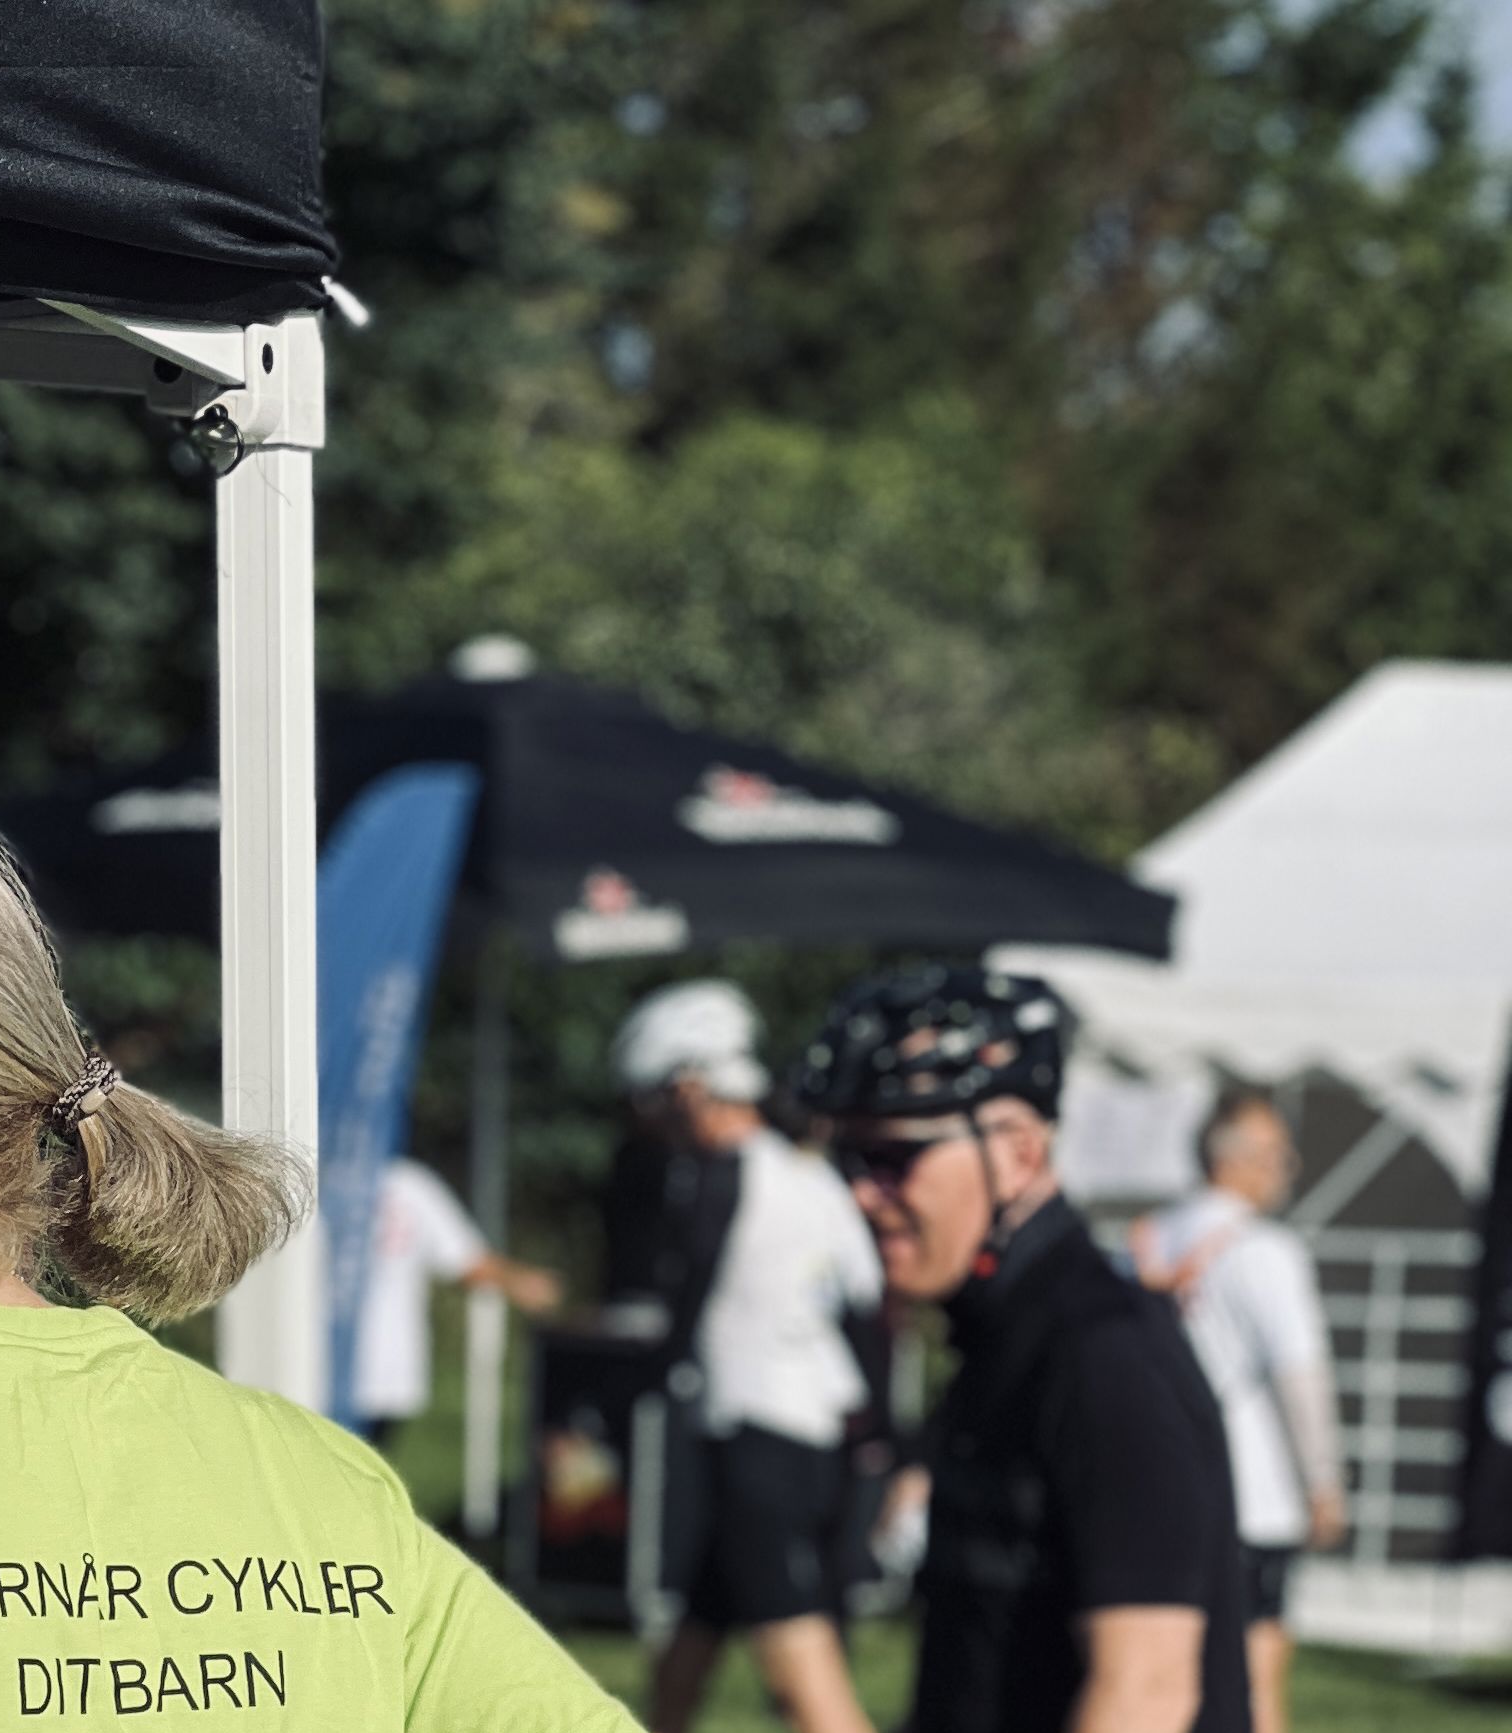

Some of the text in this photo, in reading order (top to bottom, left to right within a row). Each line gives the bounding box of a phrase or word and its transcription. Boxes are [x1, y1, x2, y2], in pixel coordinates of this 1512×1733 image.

[167, 1556, 396, 1619] CYKLER
[17, 1649, 286, 1716] DIT BARN
